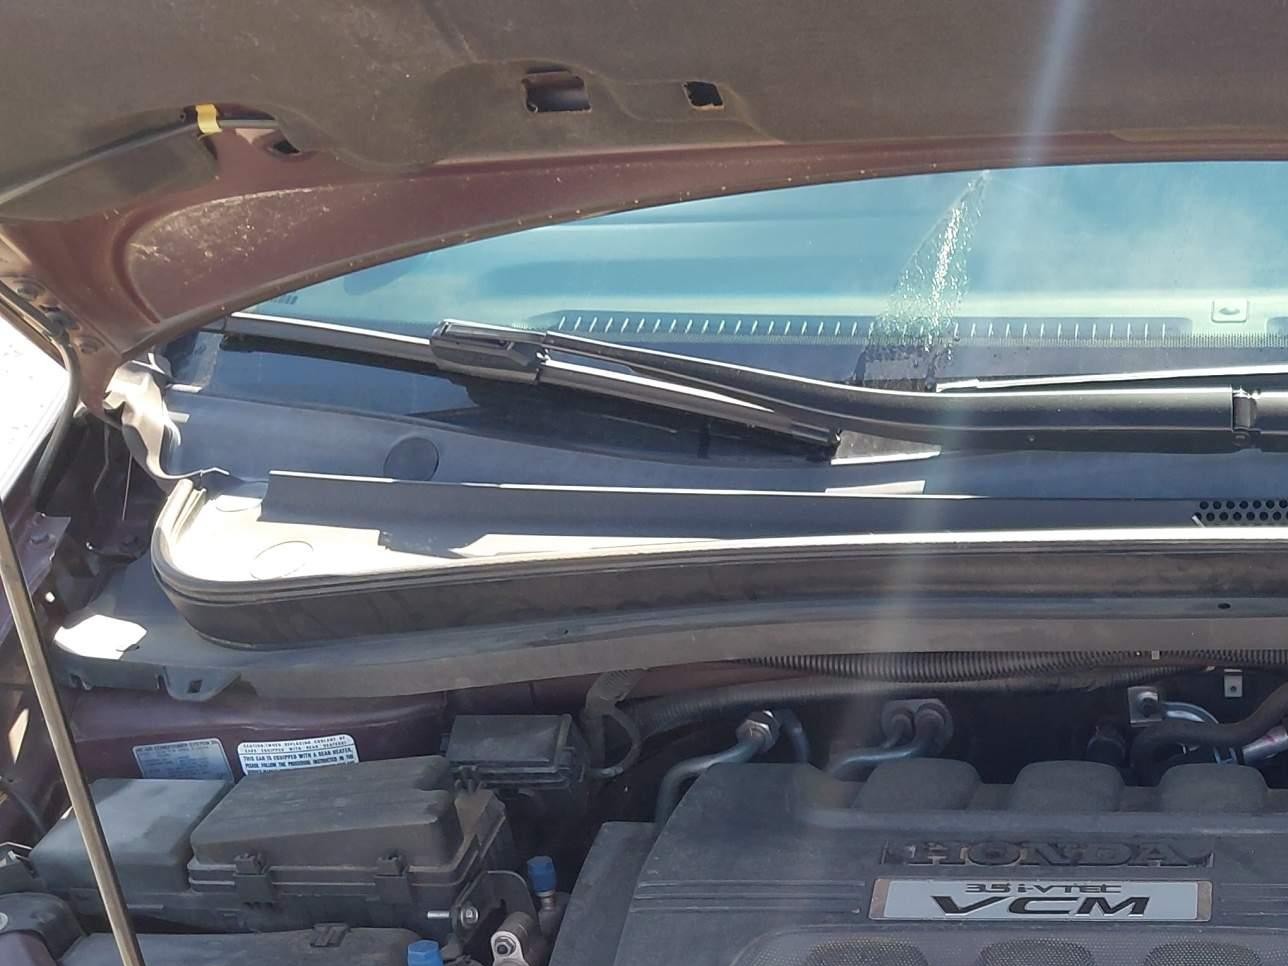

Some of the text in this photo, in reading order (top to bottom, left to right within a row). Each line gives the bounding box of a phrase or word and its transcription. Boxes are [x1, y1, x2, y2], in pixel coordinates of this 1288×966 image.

[880, 840, 1215, 868] HONDA
[1017, 883, 1122, 894] i-VTEC
[930, 895, 1151, 917] VCM
